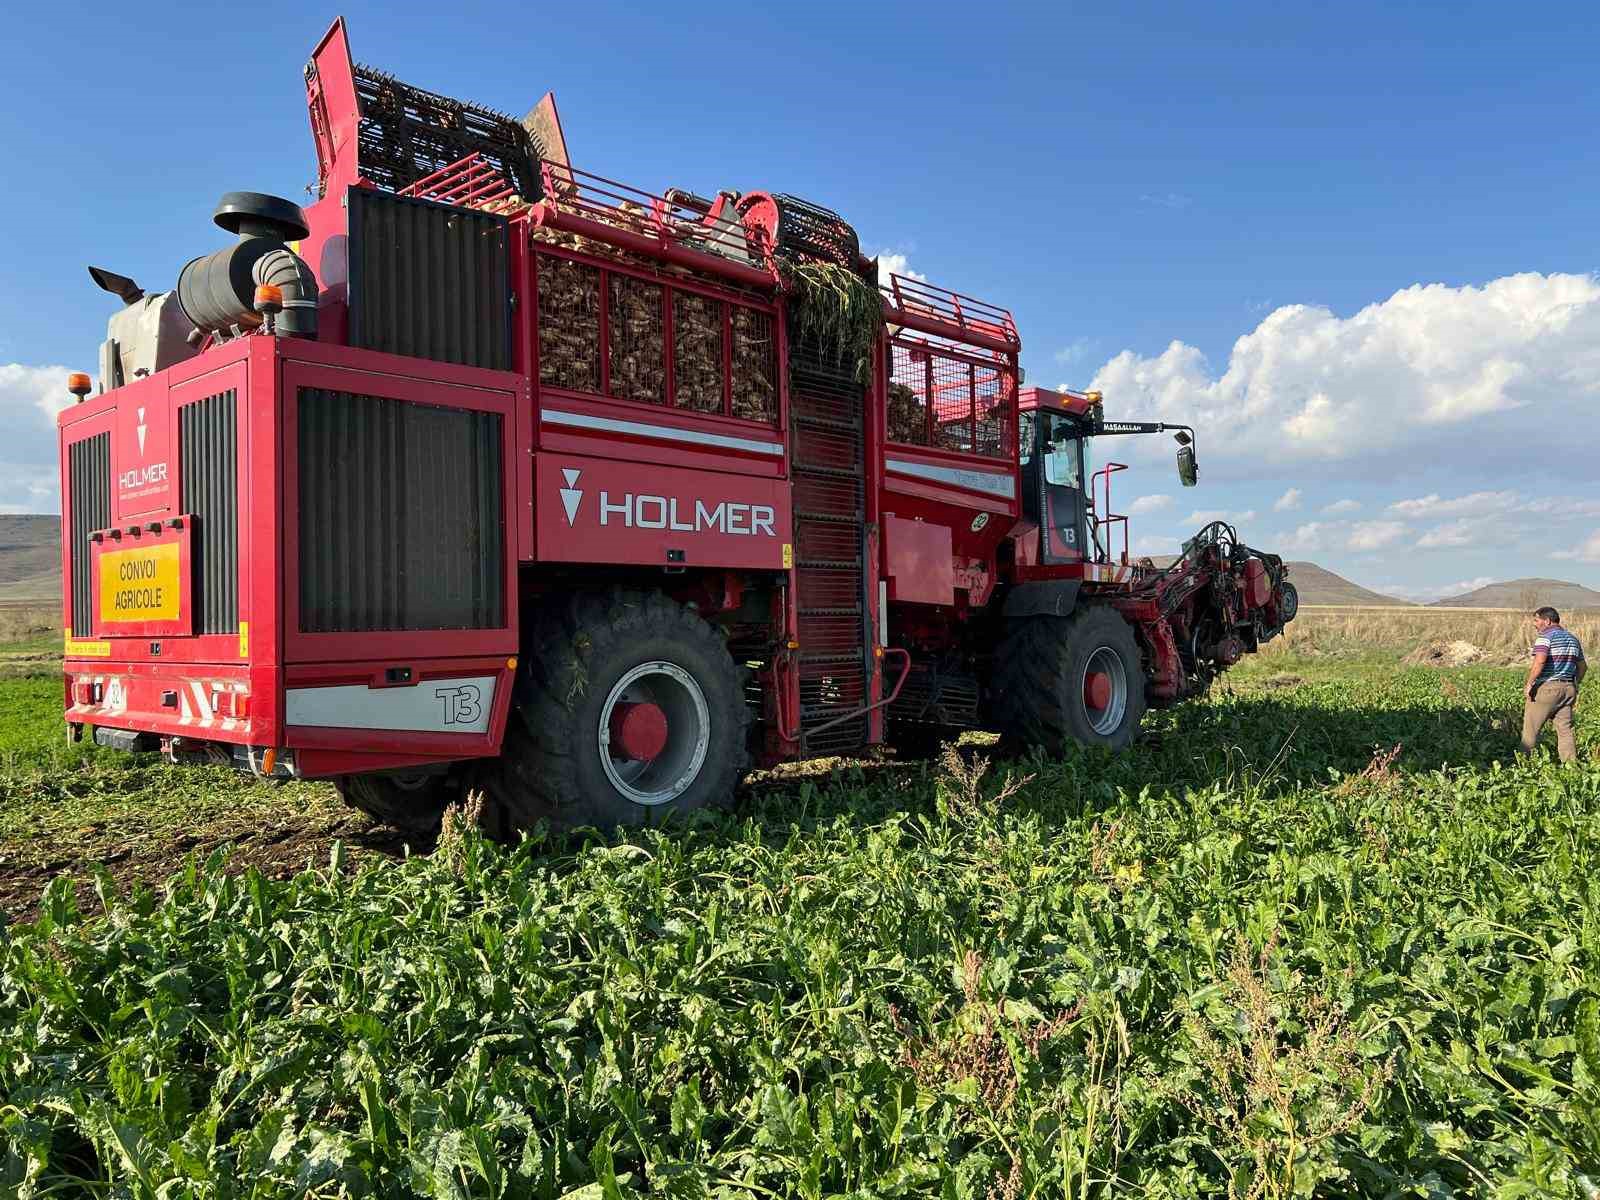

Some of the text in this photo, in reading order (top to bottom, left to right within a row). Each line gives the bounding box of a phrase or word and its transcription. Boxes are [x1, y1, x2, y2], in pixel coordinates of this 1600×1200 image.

[119, 463, 168, 490] HOLMER
[600, 491, 776, 537] HOLMER
[1063, 528, 1076, 544] T3
[120, 559, 156, 581] CONVOI
[115, 588, 162, 610] AGRICOLE
[435, 685, 482, 725] T3
